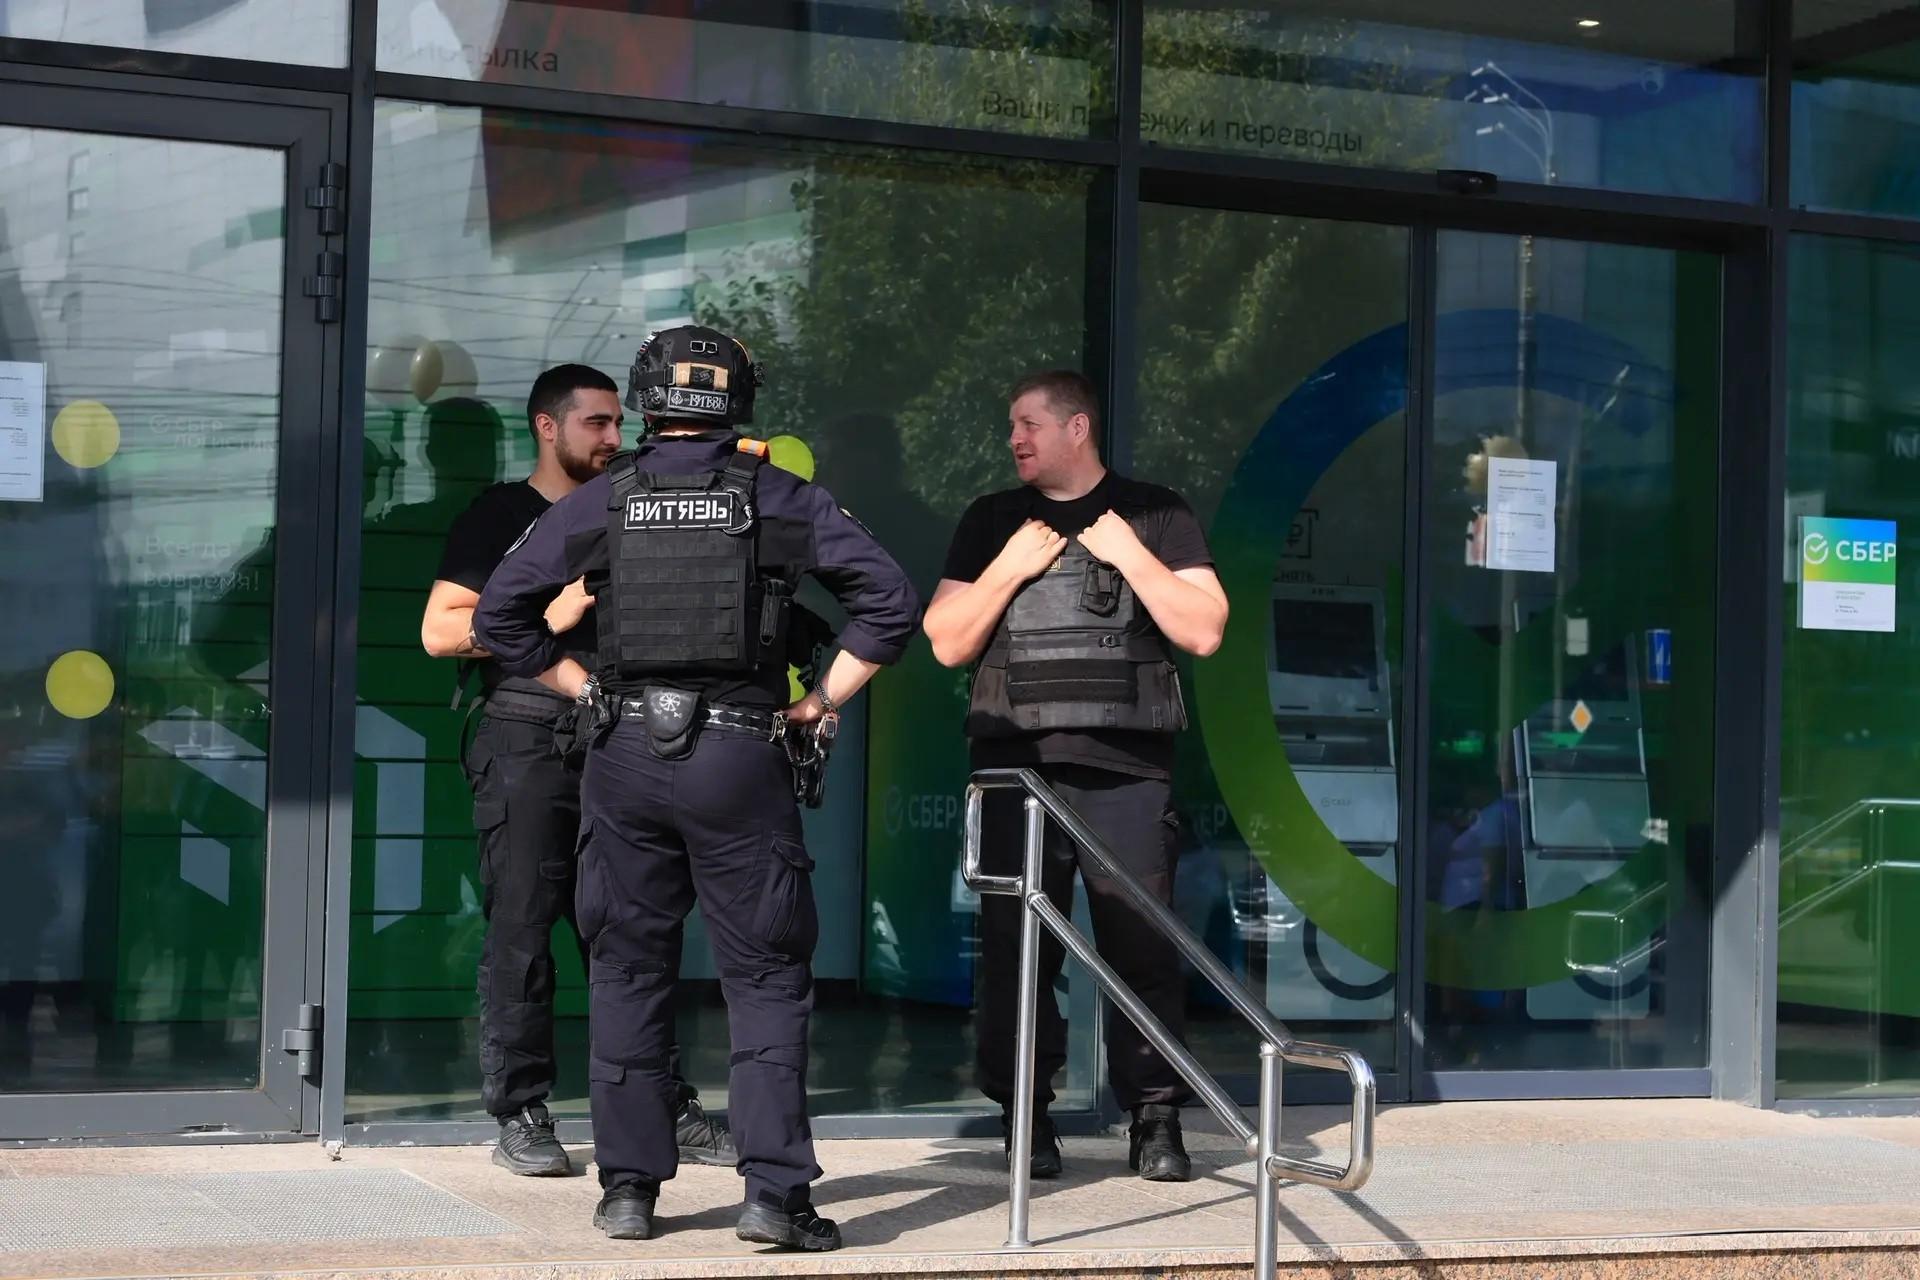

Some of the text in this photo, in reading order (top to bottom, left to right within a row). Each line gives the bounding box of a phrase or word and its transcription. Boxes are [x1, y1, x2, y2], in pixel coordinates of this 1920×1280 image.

[983, 90, 1060, 122] Ваши
[1199, 119, 1216, 138] и
[1225, 121, 1363, 154] переводы
[629, 499, 728, 521] ВИТЯЗЬ
[1835, 539, 1896, 562] СБЕР
[908, 794, 957, 829] СБЕР
